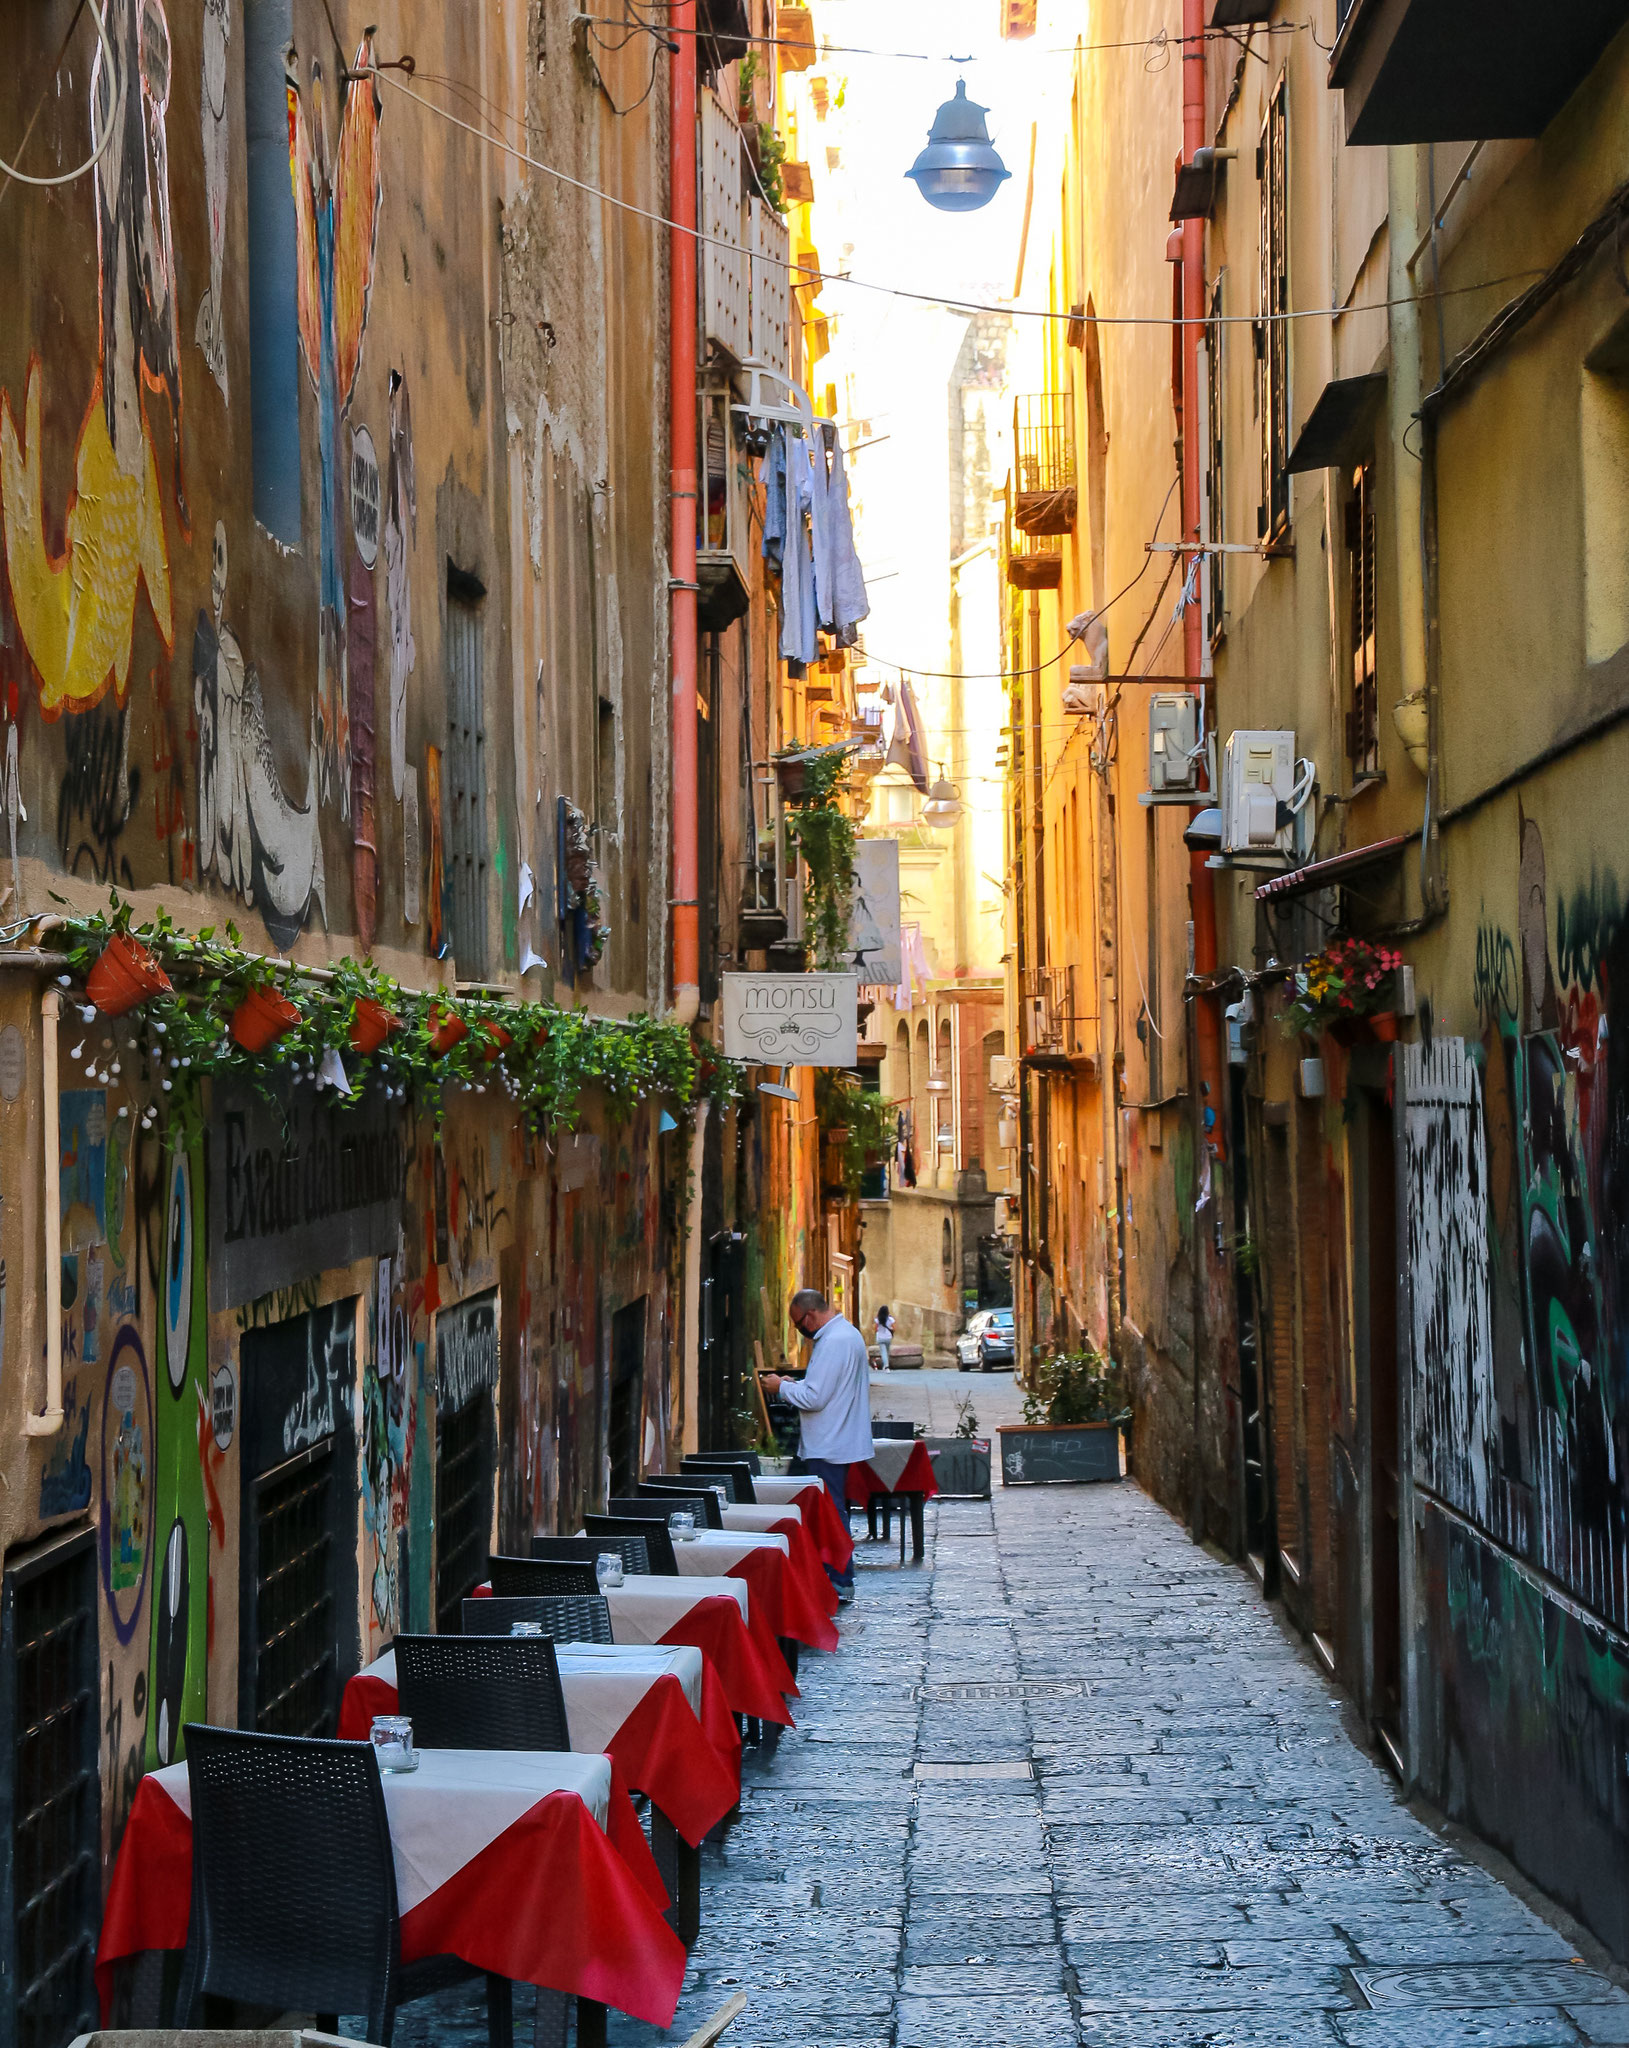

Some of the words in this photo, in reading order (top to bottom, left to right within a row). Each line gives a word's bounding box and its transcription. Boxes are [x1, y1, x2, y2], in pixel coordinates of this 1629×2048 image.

[745, 982, 835, 1009] monsù
[225, 1105, 299, 1242] Evadi
[304, 1104, 335, 1223] dal
